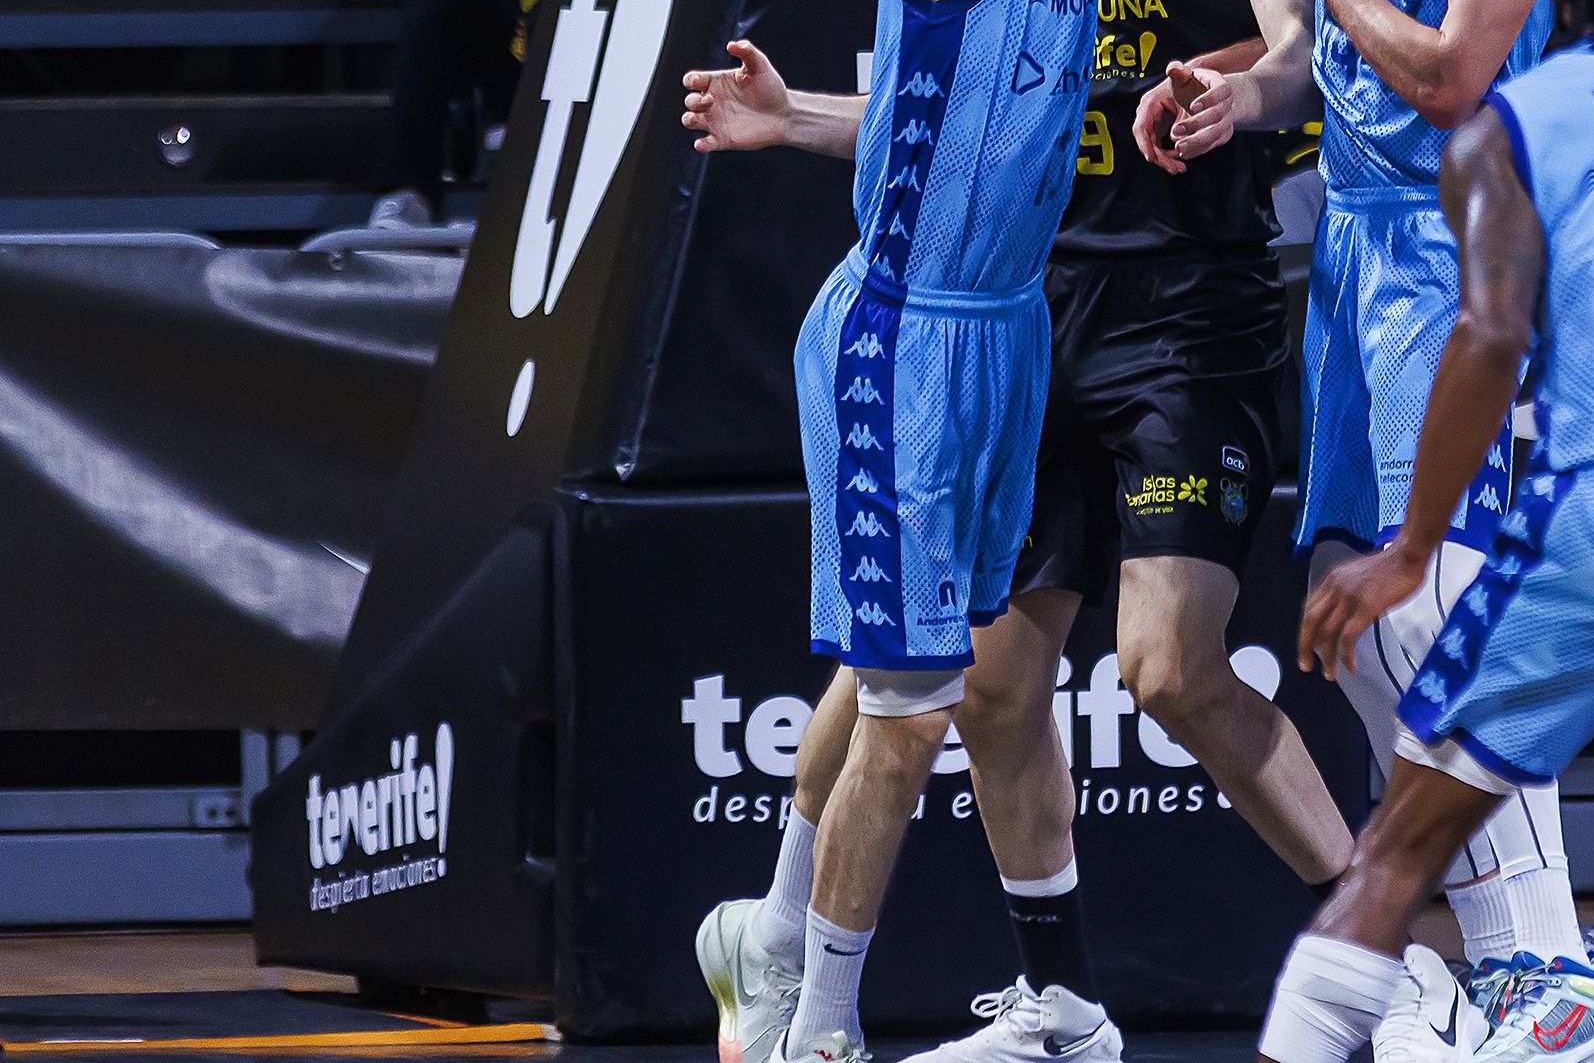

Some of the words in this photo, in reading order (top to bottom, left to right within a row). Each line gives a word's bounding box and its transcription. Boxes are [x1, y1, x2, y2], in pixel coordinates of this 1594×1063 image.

[1226, 456, 1245, 471] acb
[1380, 459, 1415, 470] andorr
[1142, 475, 1176, 492] Islas
[306, 722, 455, 877] tenerife!
[951, 780, 1204, 820] eiones
